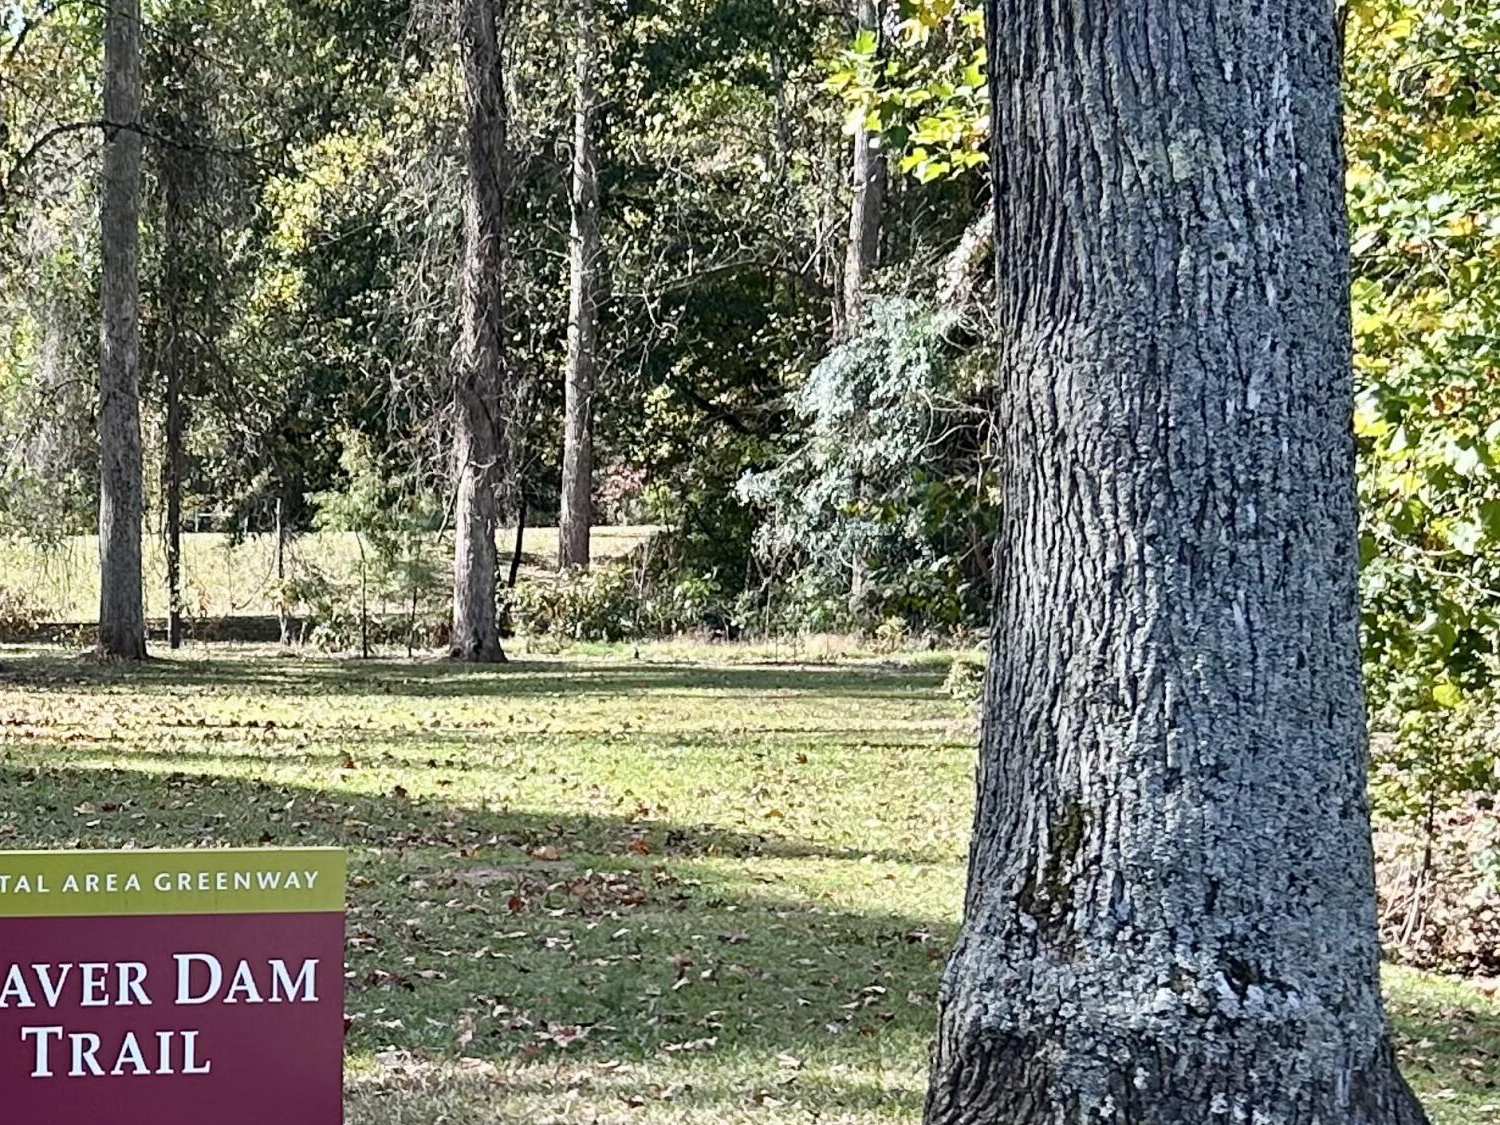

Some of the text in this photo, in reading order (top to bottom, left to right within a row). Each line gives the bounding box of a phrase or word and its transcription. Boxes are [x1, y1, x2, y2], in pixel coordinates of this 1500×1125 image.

[62, 873, 142, 893] AREA
[154, 870, 320, 892] GREENWAY
[172, 953, 320, 1005] DAM
[21, 1025, 212, 1078] TRAIL
